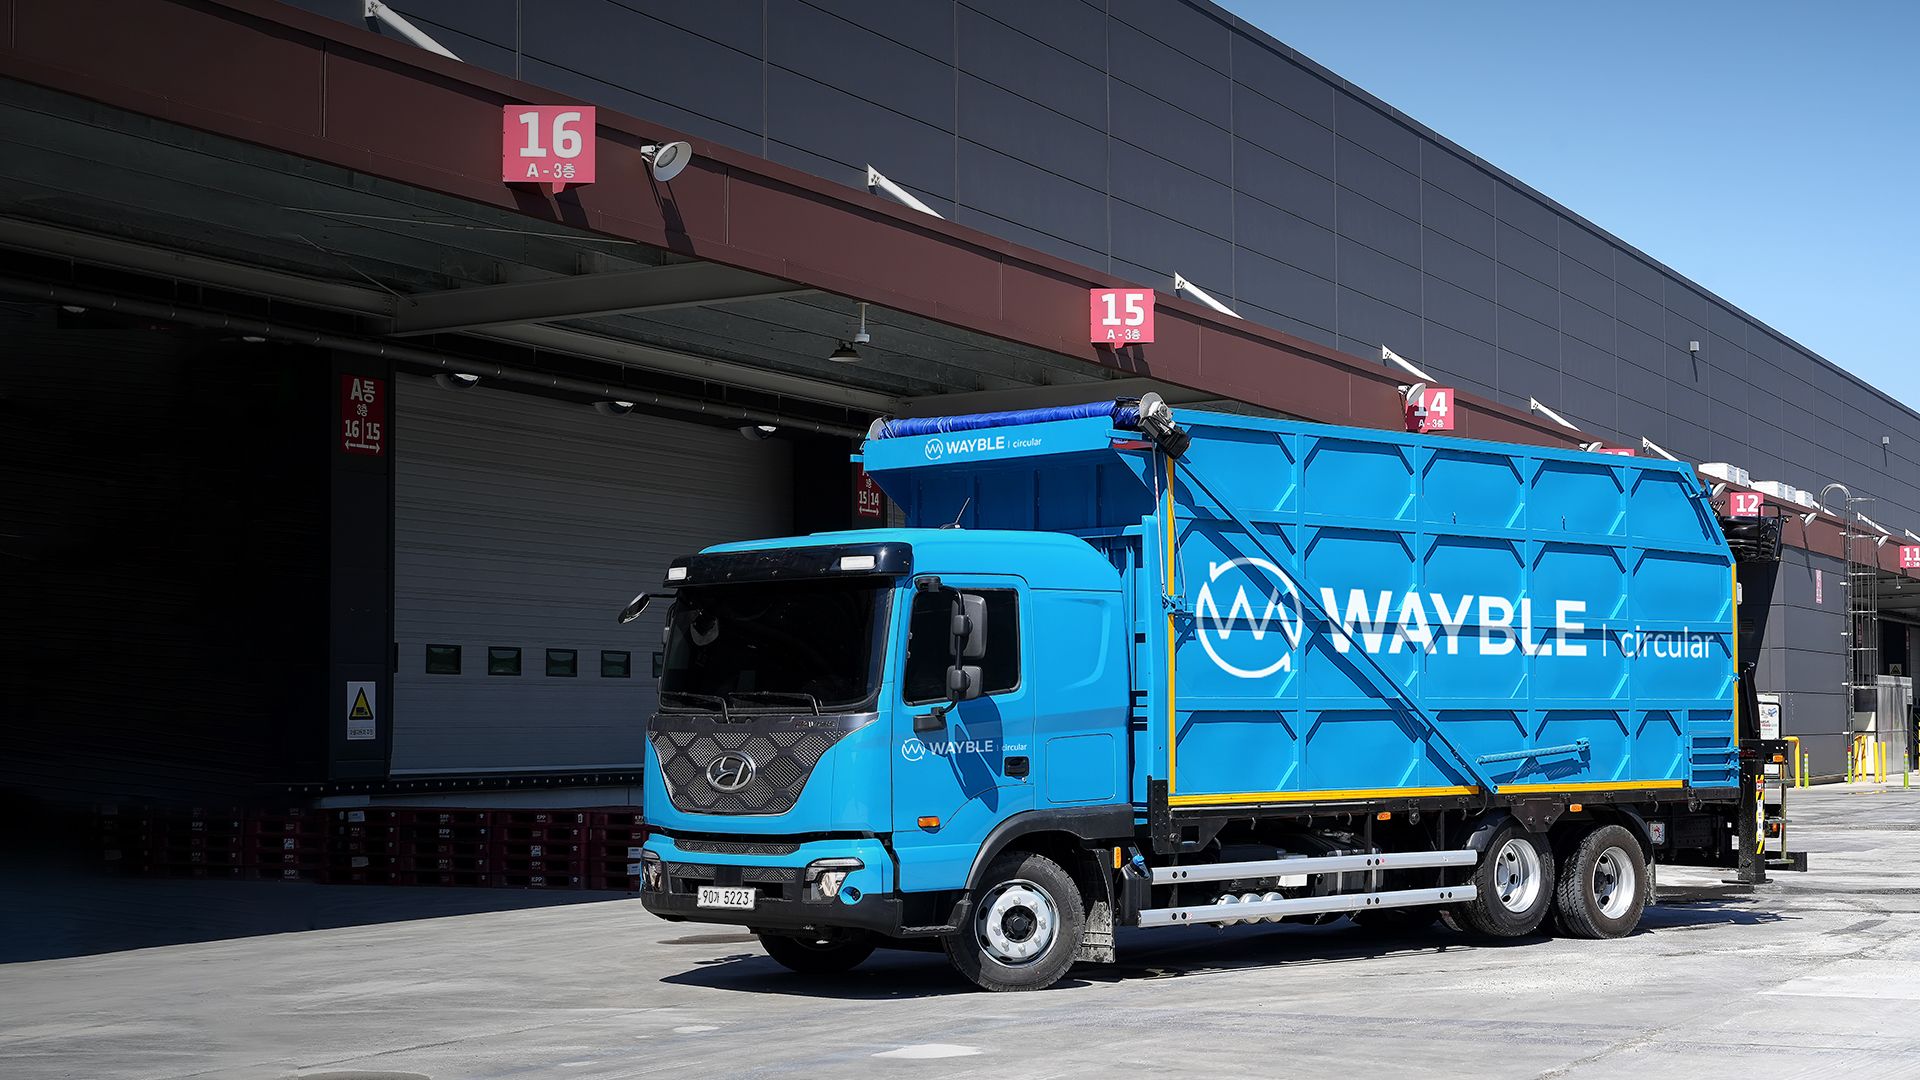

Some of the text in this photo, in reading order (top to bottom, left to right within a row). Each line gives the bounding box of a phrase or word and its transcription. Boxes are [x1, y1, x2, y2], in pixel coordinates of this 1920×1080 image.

[519, 112, 582, 158] 16
[526, 163, 539, 177] A
[553, 163, 576, 179] 3층
[1101, 293, 1144, 326] 15
[1107, 329, 1115, 340] A
[350, 378, 375, 403] A동
[1414, 391, 1448, 417] 14
[345, 419, 381, 441] 16 15
[946, 436, 1042, 455] WAYBLE circular
[859, 490, 879, 506] 15 14
[1736, 494, 1759, 513] 12
[1320, 587, 1714, 658] WAYBLE circular
[929, 740, 1028, 756] WAYBLE circular
[724, 891, 749, 905] 5223
